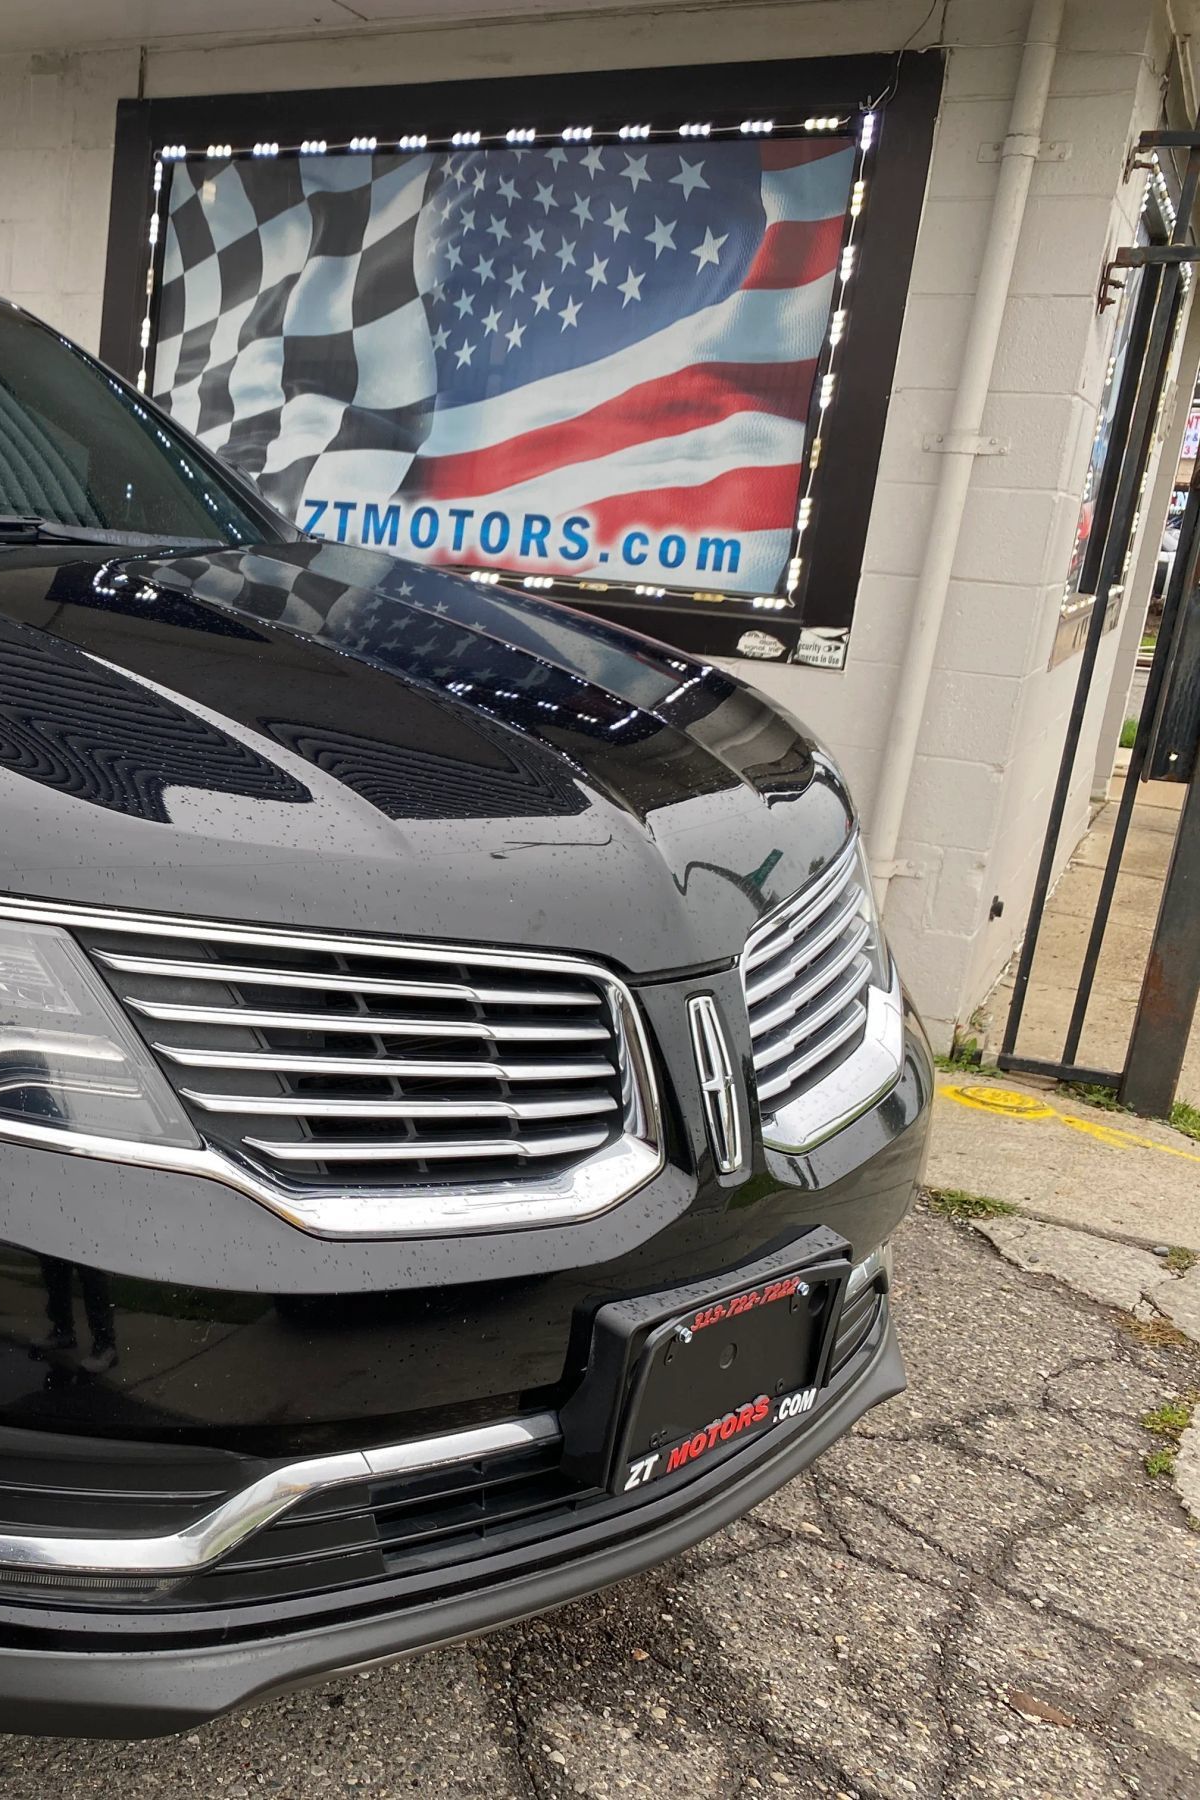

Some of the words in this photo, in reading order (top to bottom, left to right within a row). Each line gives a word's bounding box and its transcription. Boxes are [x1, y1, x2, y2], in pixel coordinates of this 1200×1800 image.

[301, 499, 742, 574] ZTMOTORS.com
[799, 642, 821, 654] ecurity
[623, 1453, 660, 1491] ZT
[666, 1394, 771, 1473] MOTORS
